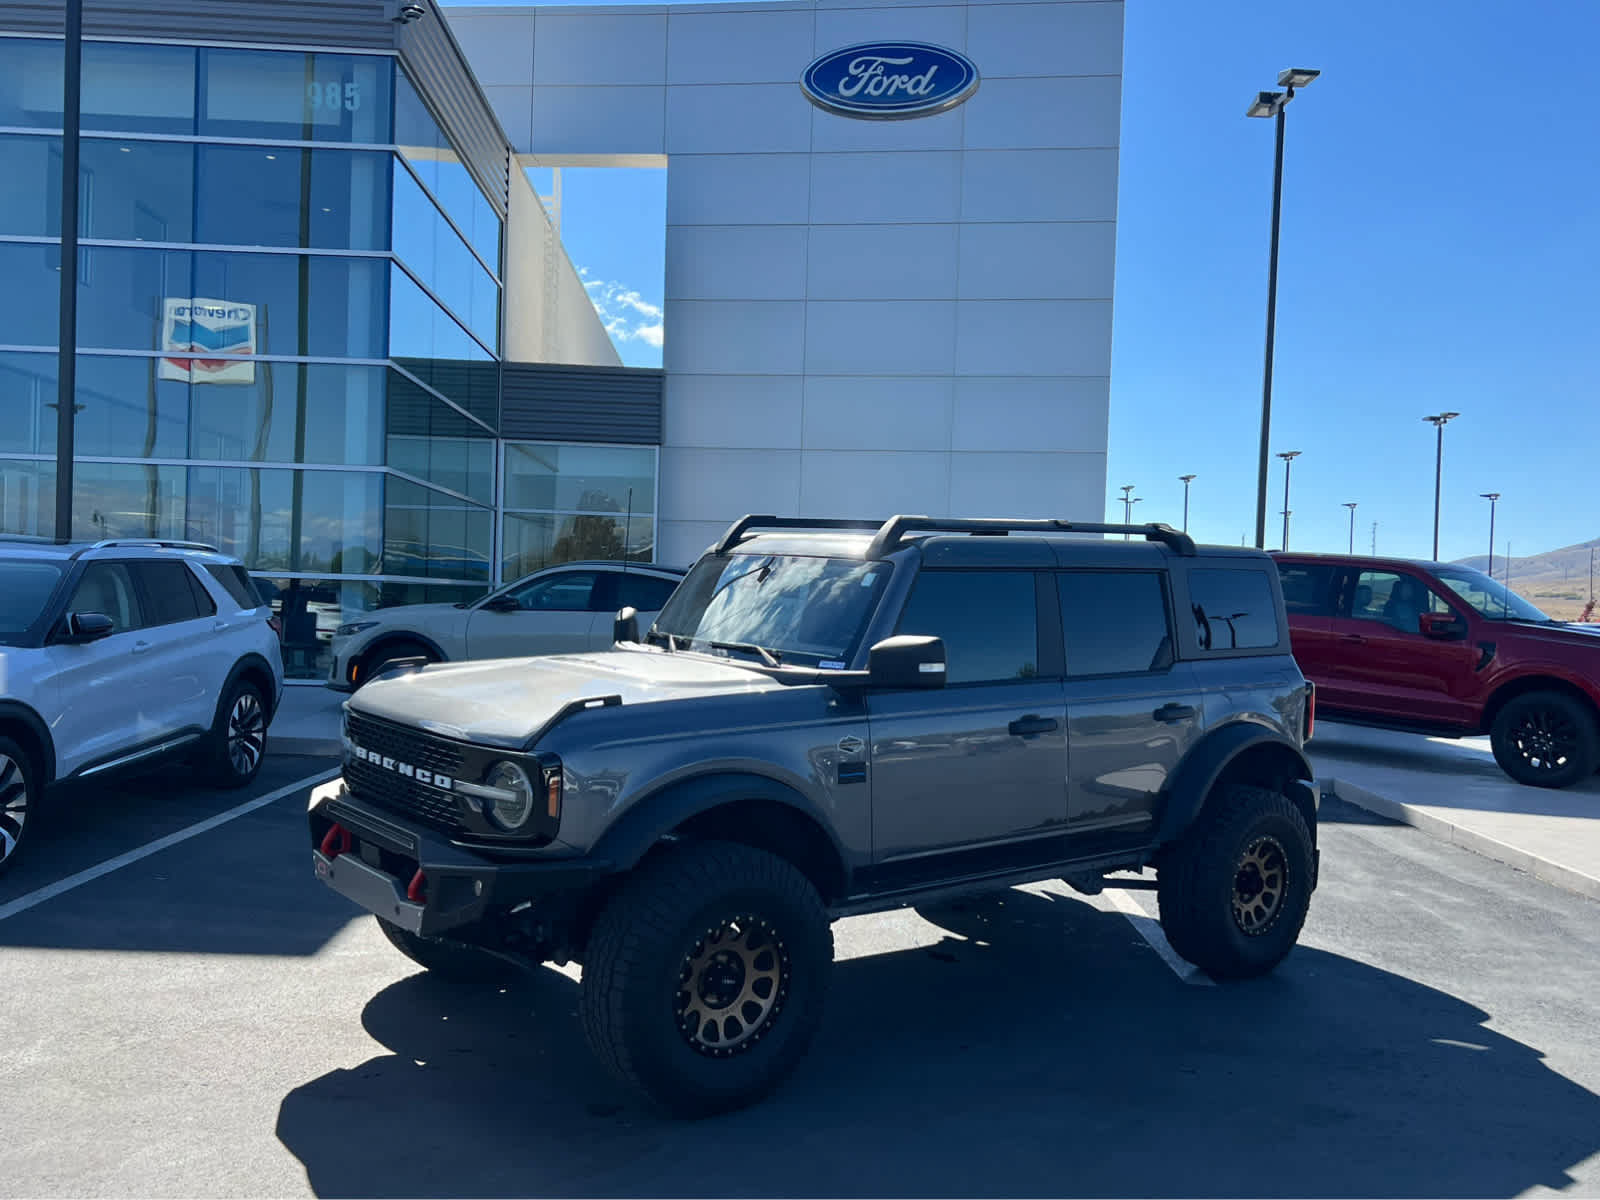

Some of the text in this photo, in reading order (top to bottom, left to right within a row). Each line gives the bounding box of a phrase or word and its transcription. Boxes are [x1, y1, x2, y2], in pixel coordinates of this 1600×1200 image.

[838, 56, 938, 96] Ford
[307, 82, 361, 111] 985
[356, 746, 452, 789] BRONCO
